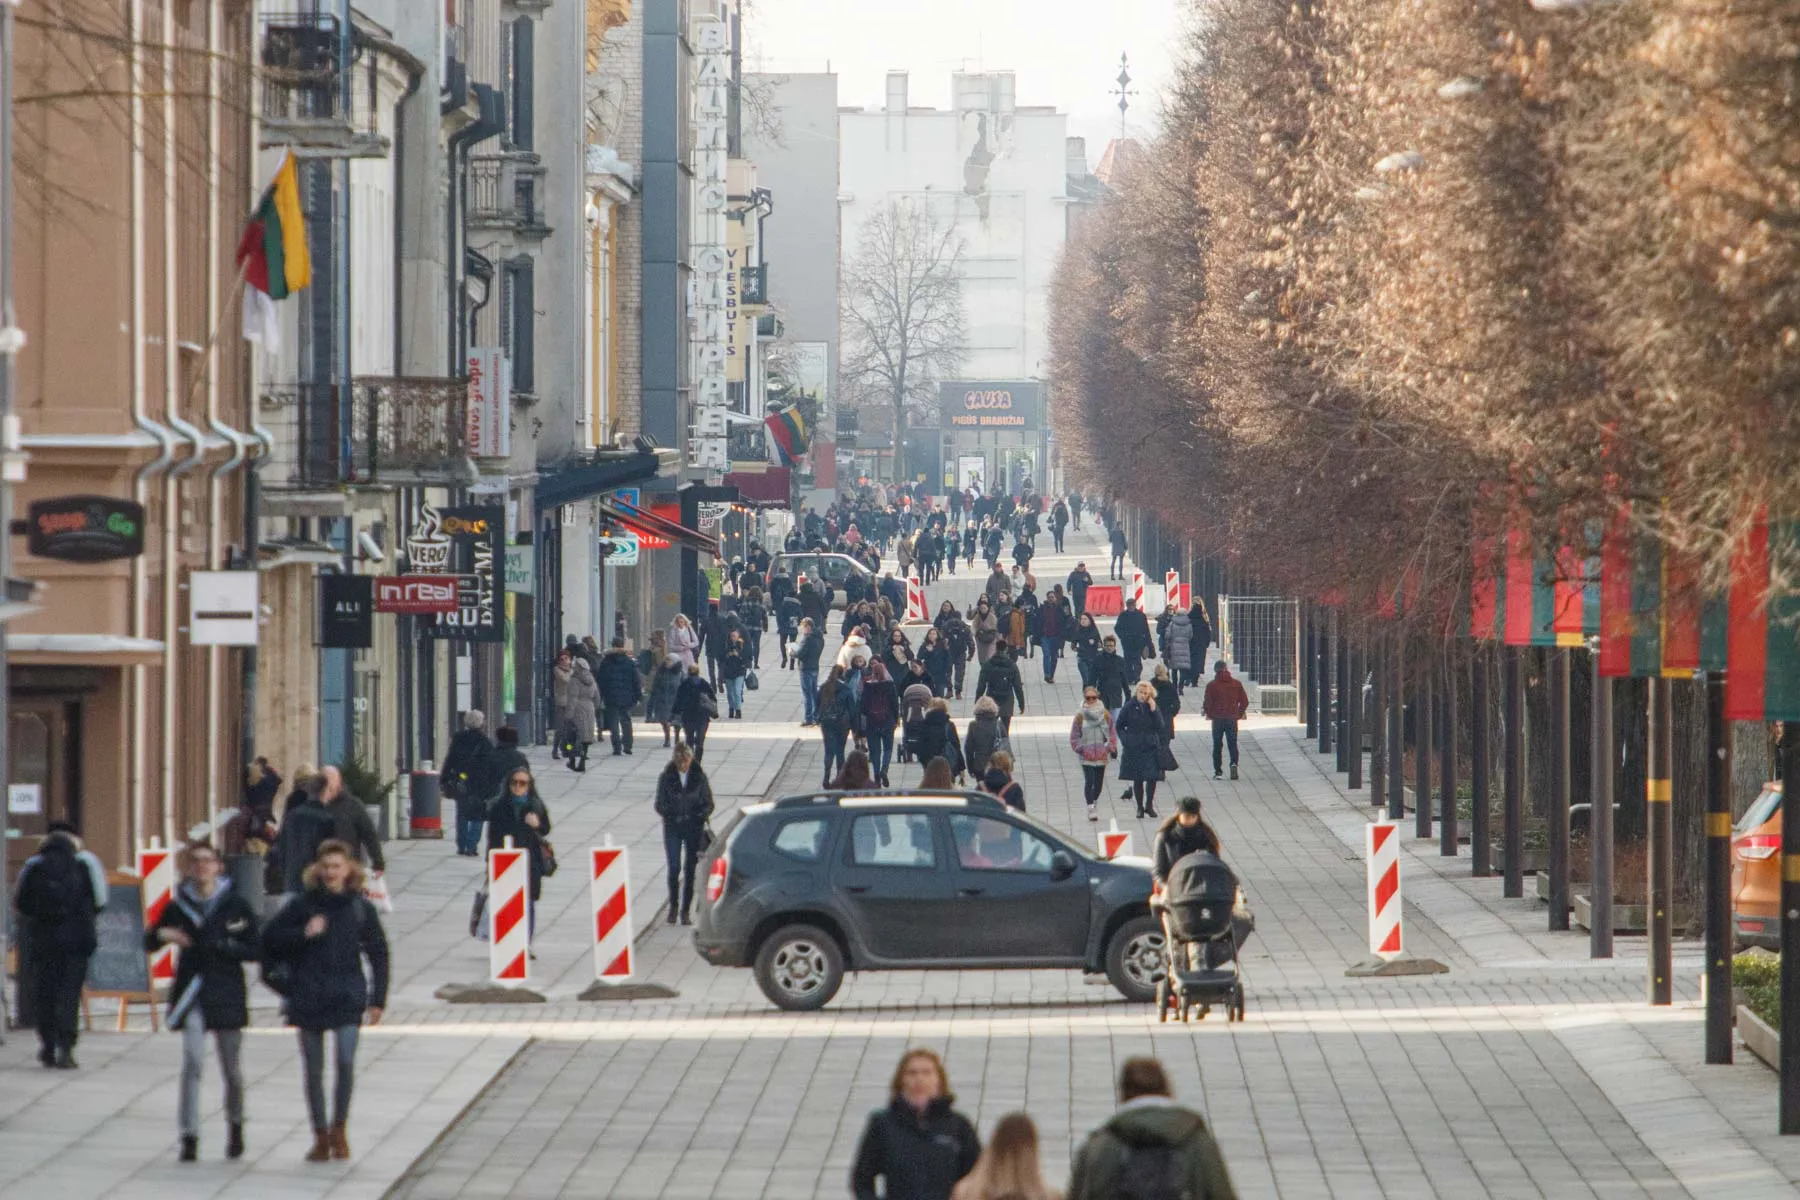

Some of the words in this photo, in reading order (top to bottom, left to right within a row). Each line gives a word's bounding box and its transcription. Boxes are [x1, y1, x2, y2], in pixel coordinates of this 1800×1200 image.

[701, 22, 725, 209] BALTIC
[726, 248, 736, 356] VIESBUTIS
[700, 248, 724, 466] CLIPPER
[964, 391, 1012, 410] CAUSA
[562, 503, 575, 523] 17
[410, 545, 448, 562] VERO
[405, 582, 454, 600] real
